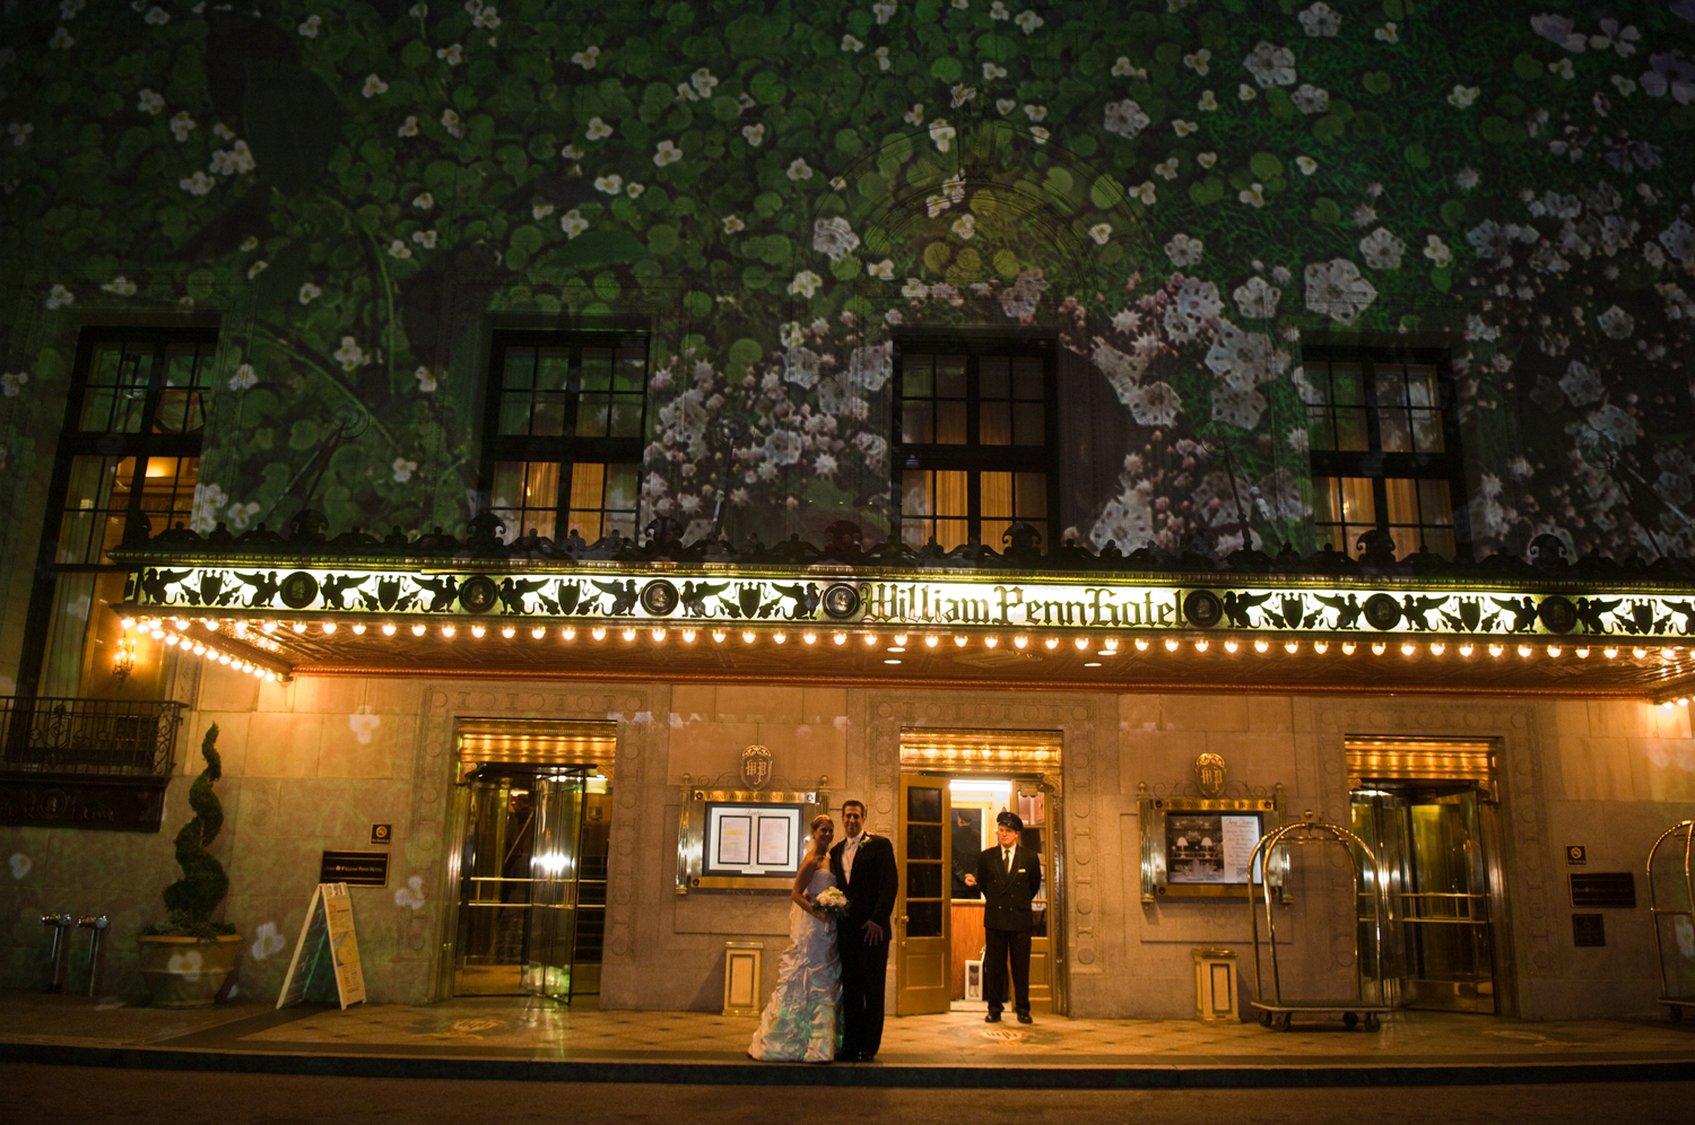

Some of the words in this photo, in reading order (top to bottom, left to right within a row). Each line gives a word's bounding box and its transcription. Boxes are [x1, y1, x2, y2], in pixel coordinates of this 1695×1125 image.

[860, 583, 991, 623] William
[992, 586, 1089, 626] Penn
[1085, 588, 1188, 627] Hotel
